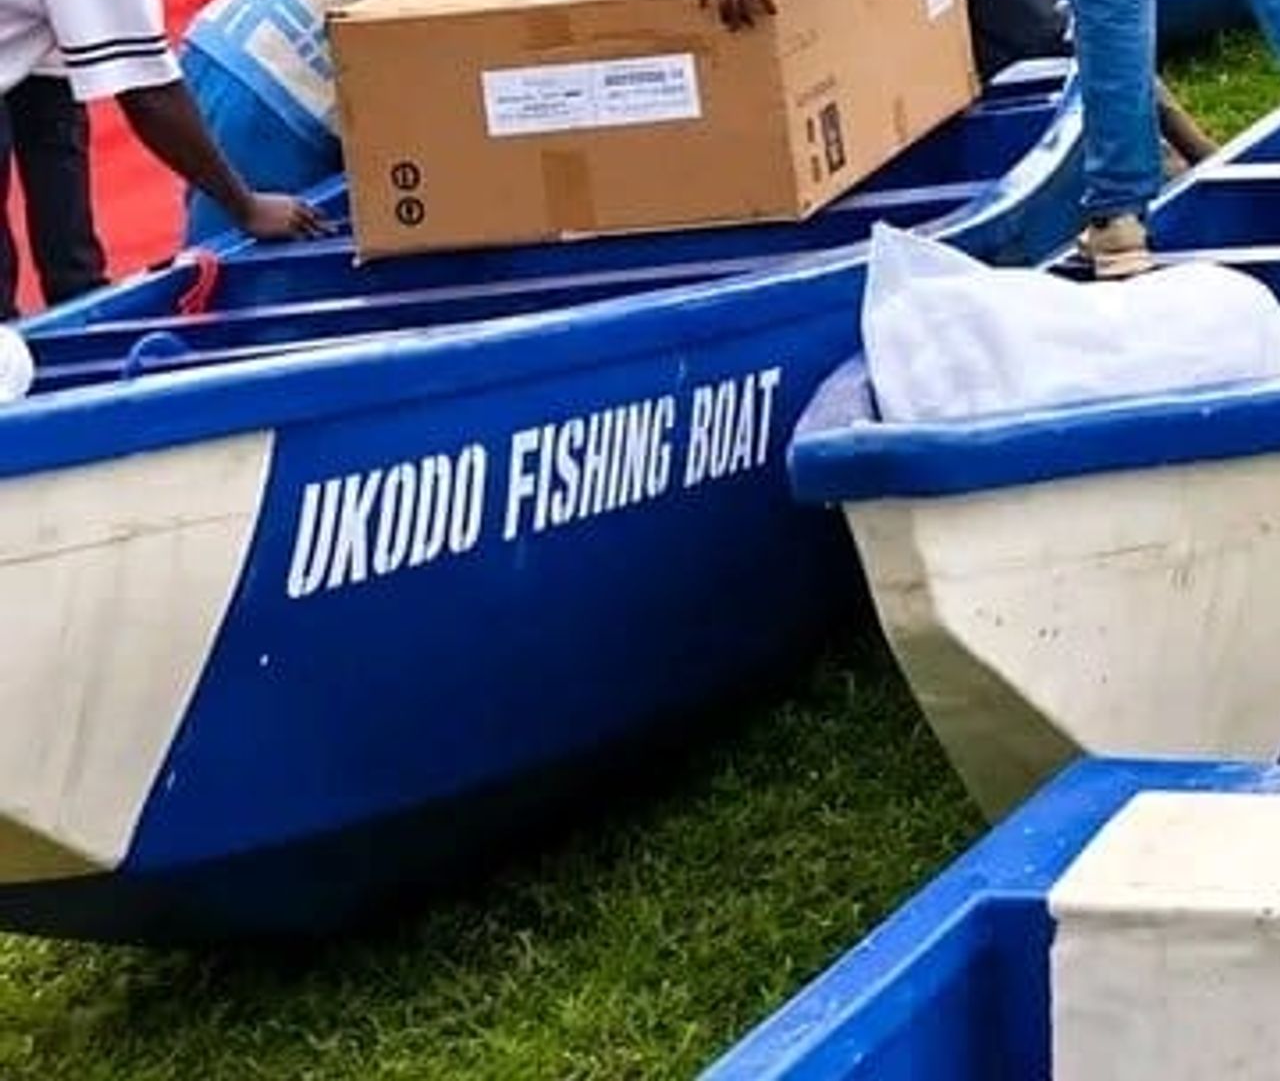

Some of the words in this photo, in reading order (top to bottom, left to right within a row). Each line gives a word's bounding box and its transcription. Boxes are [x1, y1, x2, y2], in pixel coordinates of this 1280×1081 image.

[287, 441, 488, 600] UKODO
[503, 394, 675, 542] FISHING
[683, 366, 782, 489] BOAT
